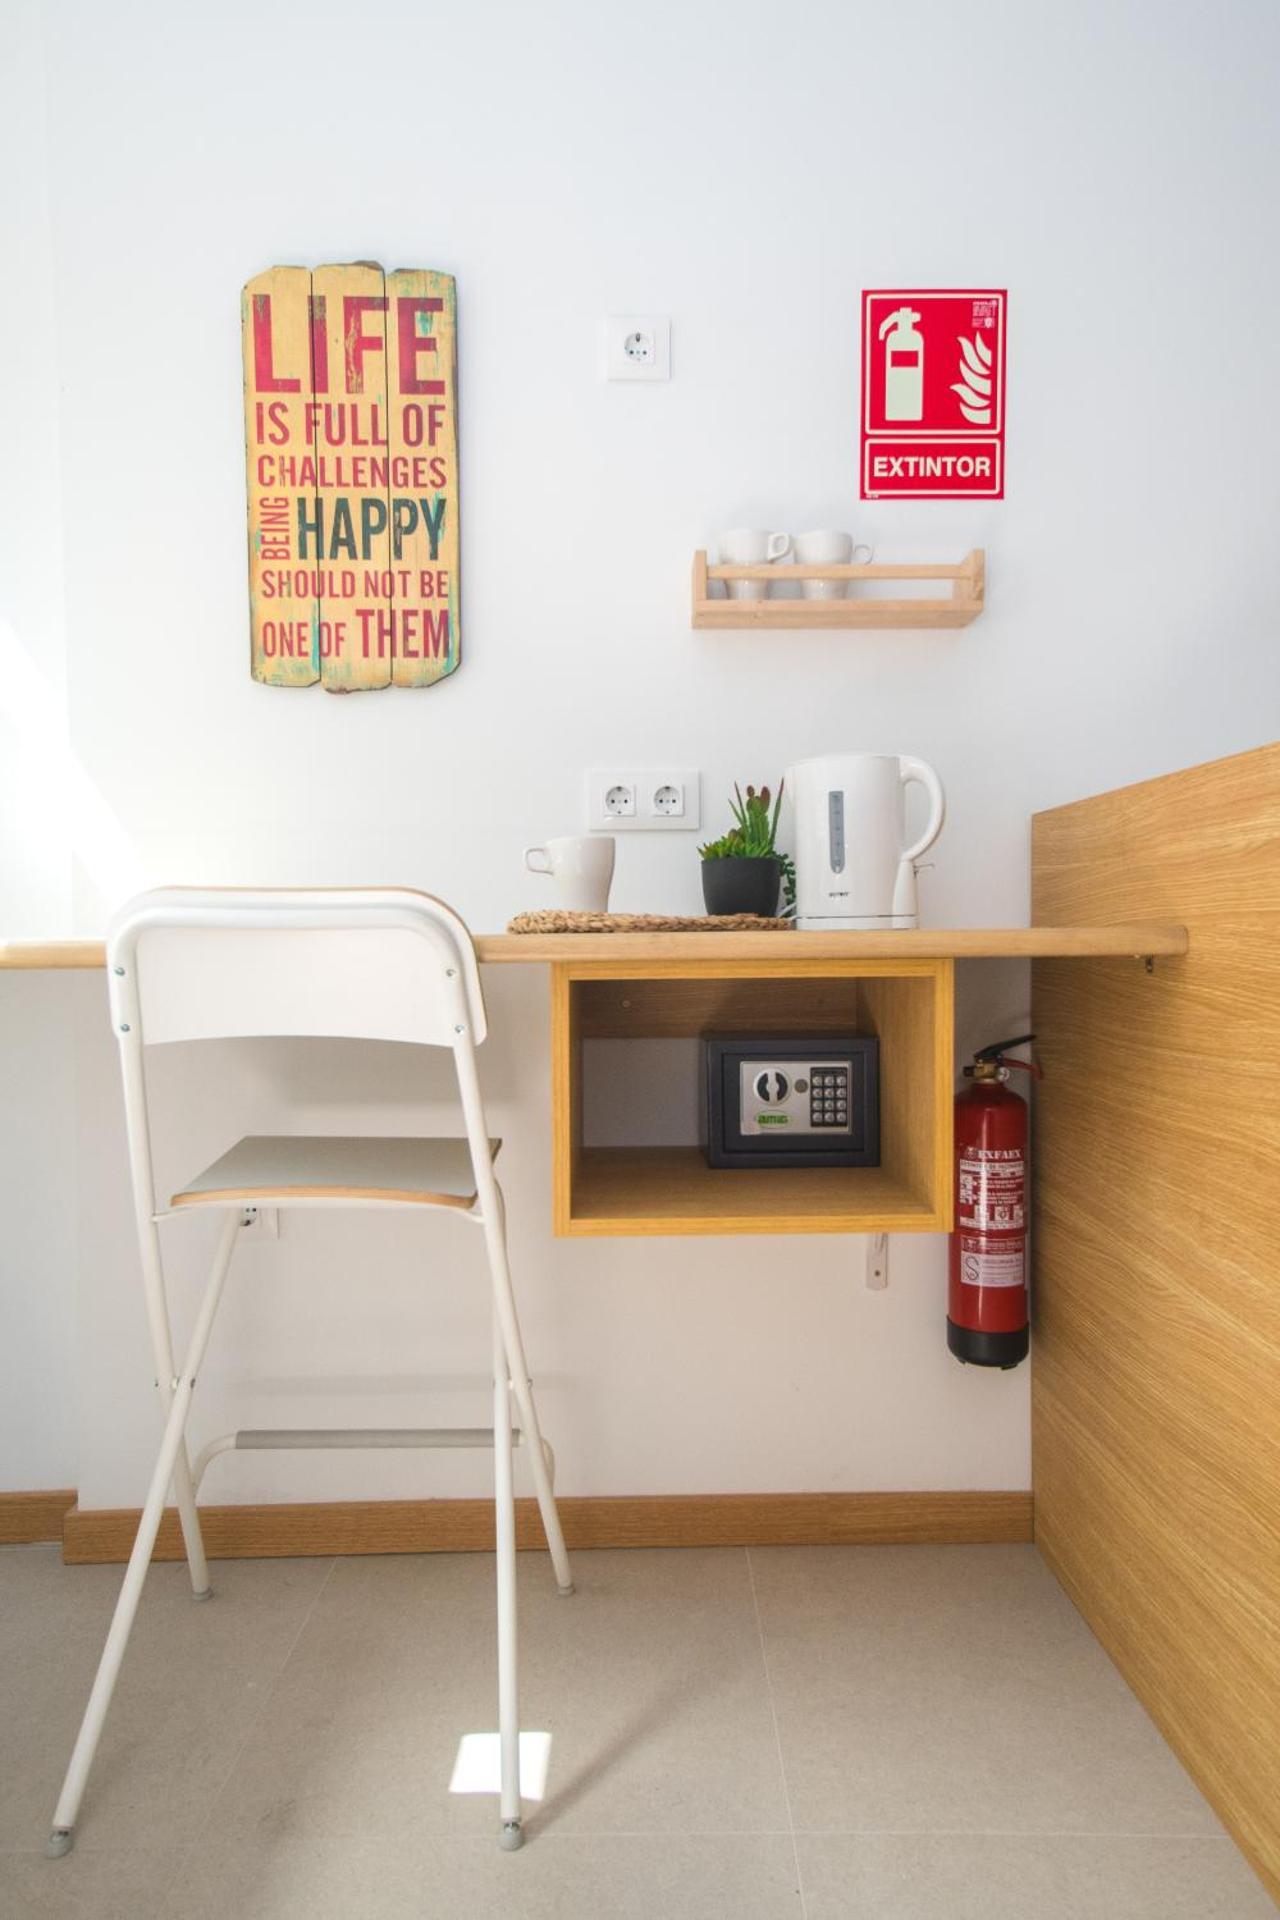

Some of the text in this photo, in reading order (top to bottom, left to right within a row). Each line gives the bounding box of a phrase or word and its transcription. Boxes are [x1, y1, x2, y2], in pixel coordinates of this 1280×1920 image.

[252, 294, 446, 395] LIFE
[255, 401, 446, 448] IS FULL OF
[257, 454, 448, 489] CHALLENGES
[873, 456, 991, 478] EXTINTOR
[259, 497, 291, 561] BEING
[296, 497, 447, 561] HAPPY
[261, 569, 449, 599] SHOULD NOT BE
[261, 608, 450, 659] ONE OF THEM
